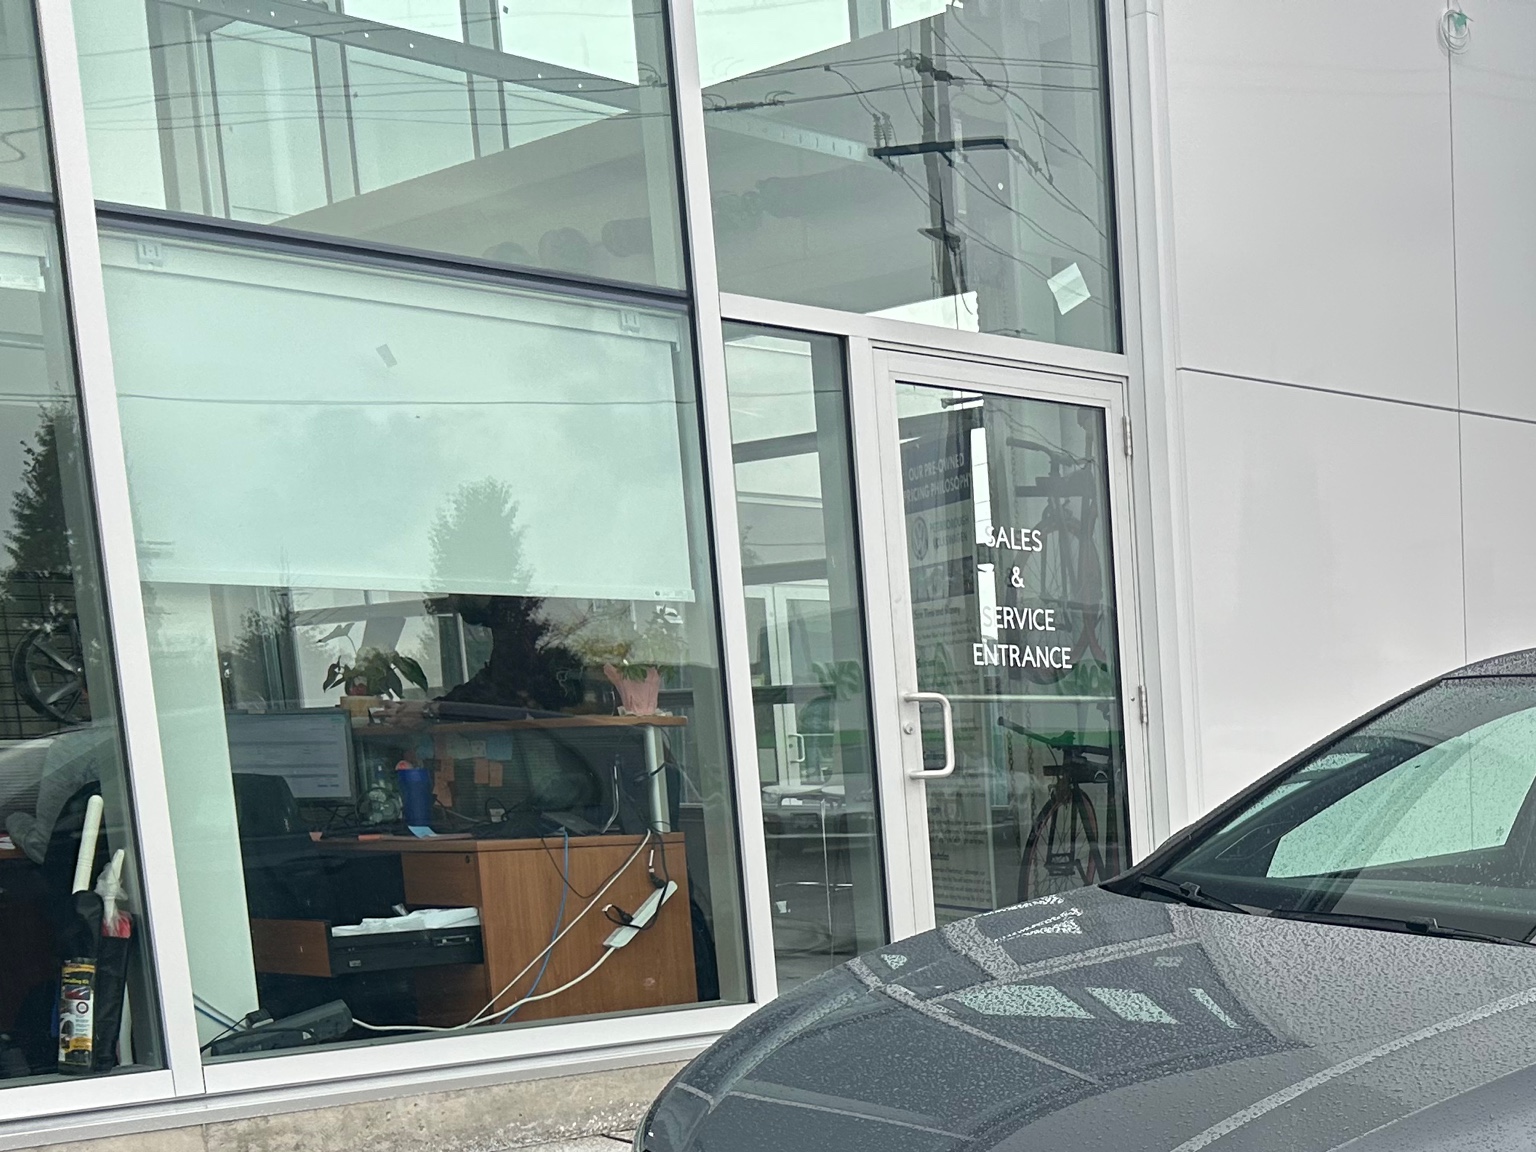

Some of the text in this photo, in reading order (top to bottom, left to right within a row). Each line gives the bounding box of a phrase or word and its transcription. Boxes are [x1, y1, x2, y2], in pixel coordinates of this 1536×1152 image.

[984, 525, 1043, 552] SALES
[1011, 566, 1025, 588] &
[982, 606, 1056, 632] SERVICE
[973, 643, 1073, 669] ENTRANCE
